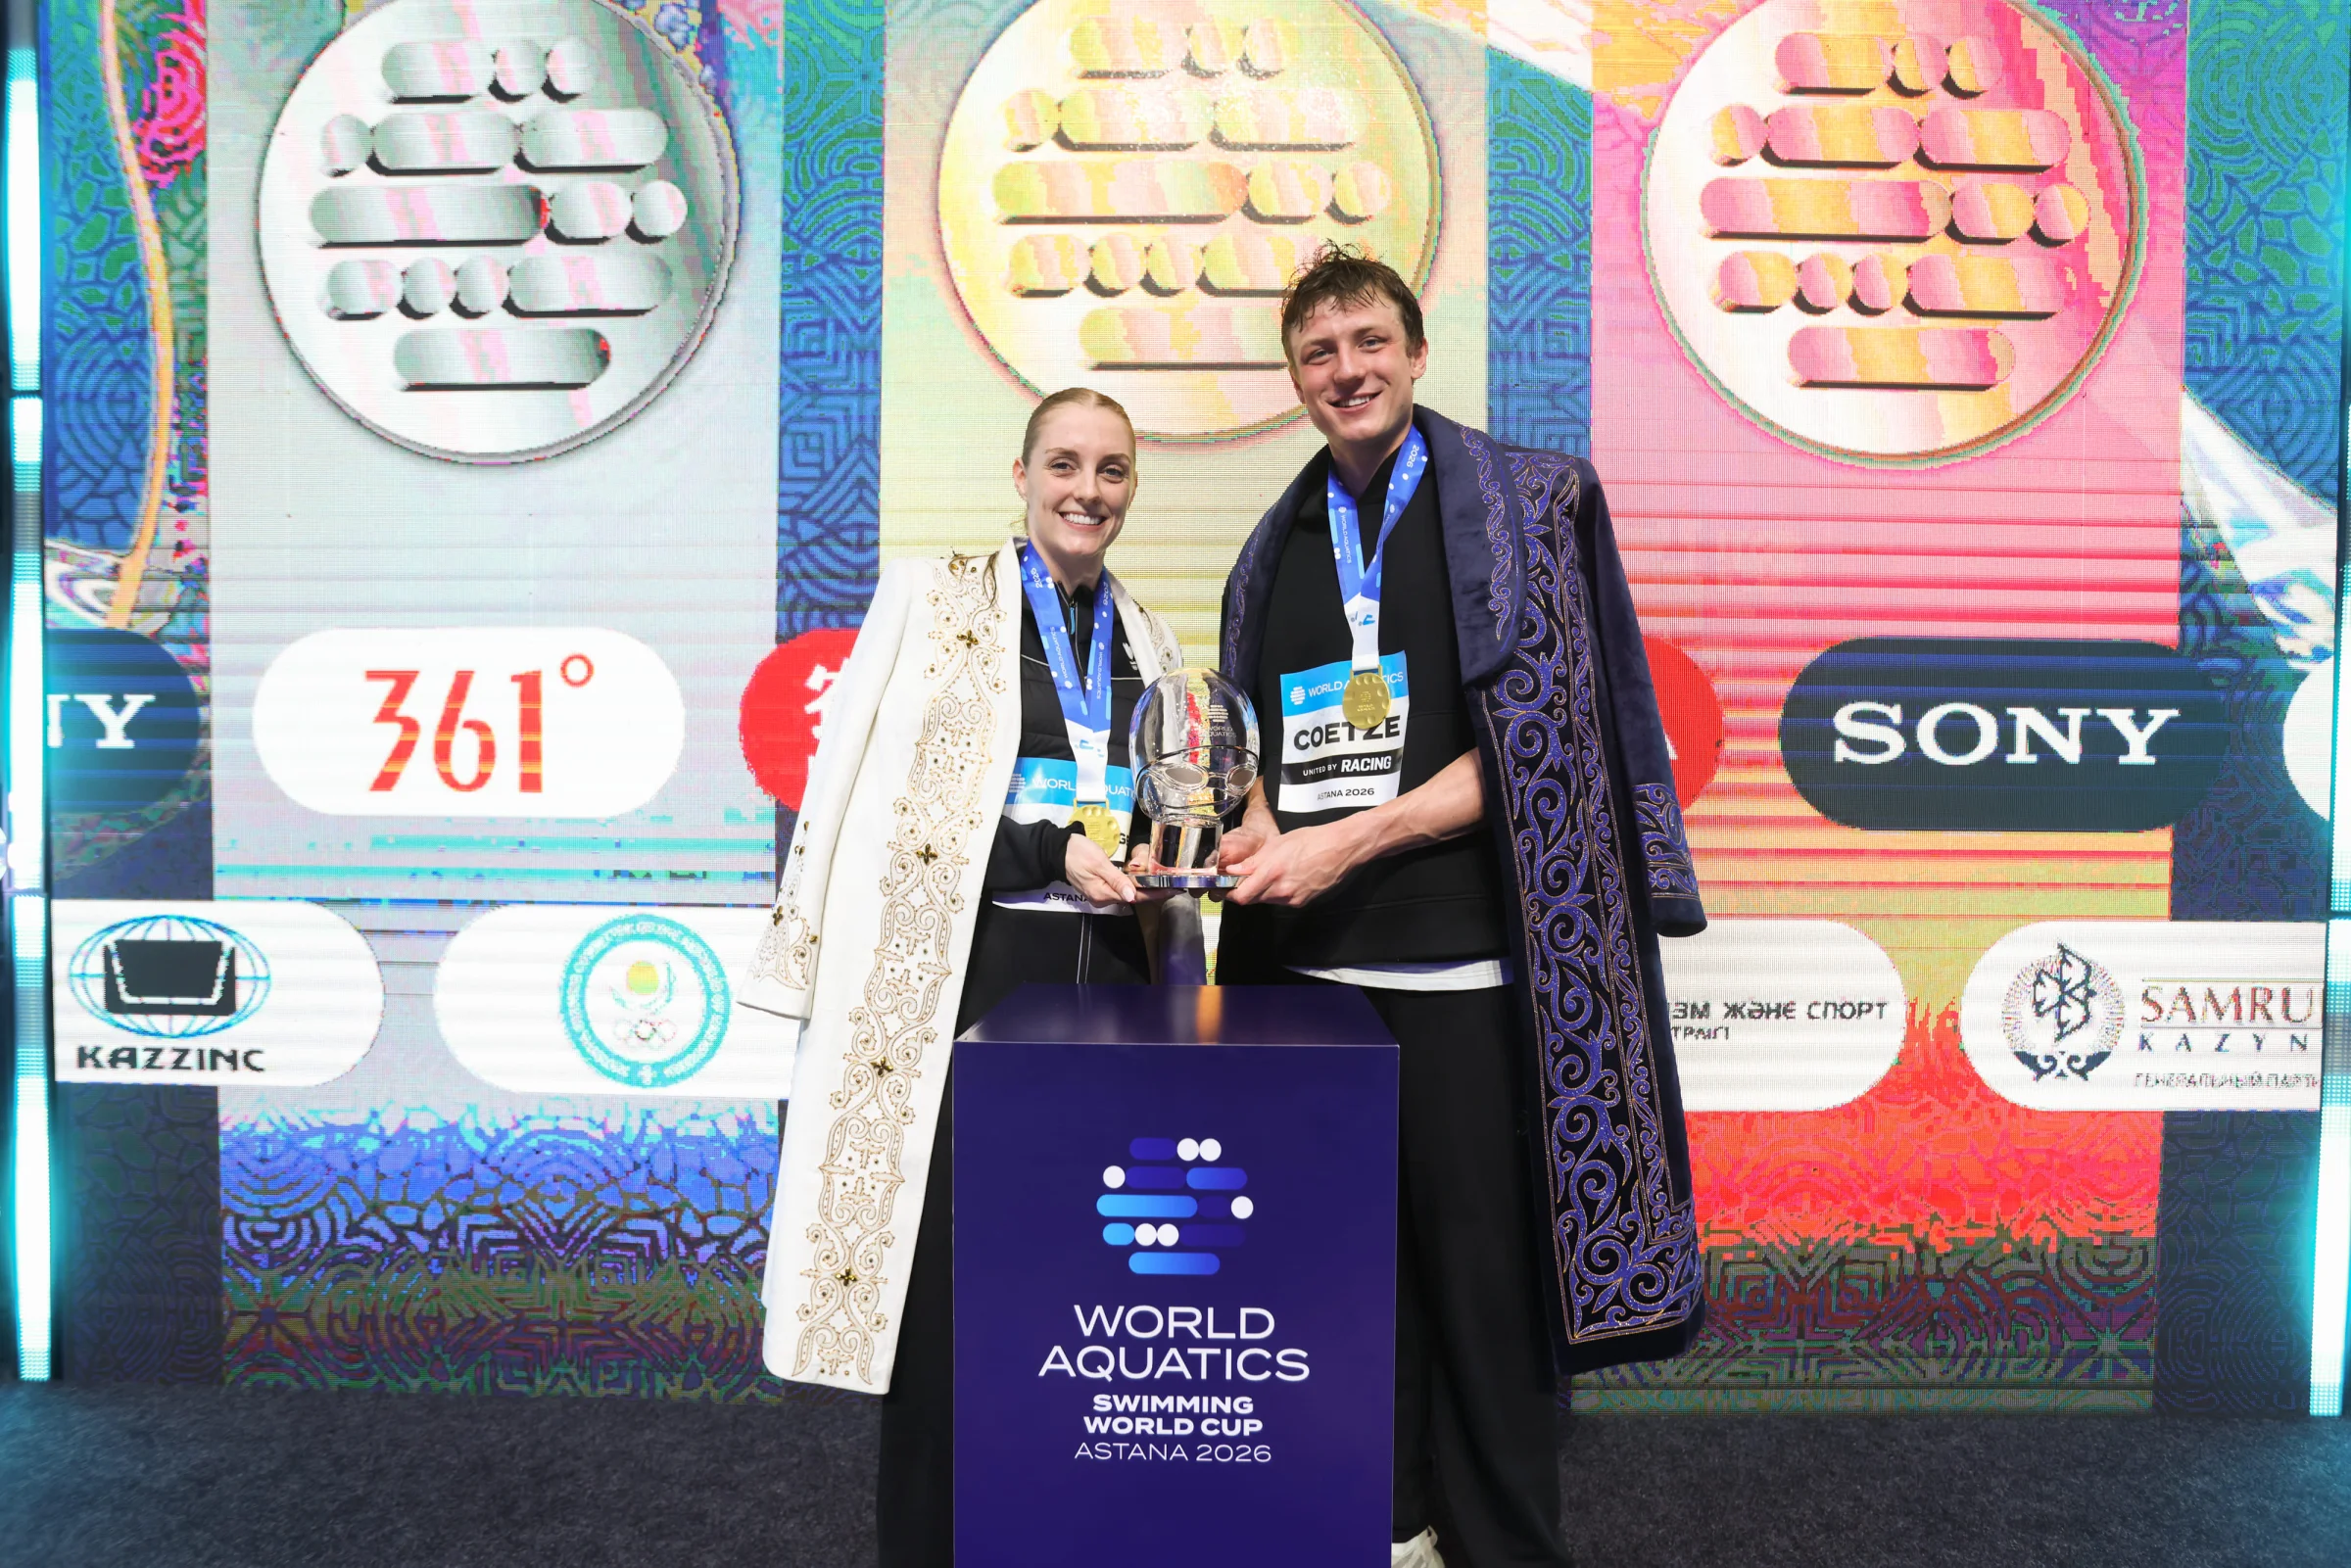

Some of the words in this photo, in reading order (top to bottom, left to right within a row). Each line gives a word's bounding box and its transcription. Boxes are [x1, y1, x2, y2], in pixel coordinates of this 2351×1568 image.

[1405, 444, 1420, 469] 2026
[1339, 514, 1349, 536] WORLD
[1342, 536, 1353, 564] AQUATICS
[1030, 567, 1043, 589] 2026
[1049, 626, 1062, 656] AQUATICS
[1058, 656, 1068, 679] WORLD
[1308, 681, 1343, 697] WORLD
[1832, 701, 2181, 766] SONY
[1303, 766, 1326, 777] UNITED
[1327, 763, 1337, 772] BY
[1340, 755, 1392, 773] RACING
[1032, 778, 1077, 791] WORL
[1317, 788, 1343, 801] ASTANA
[1345, 787, 1375, 797] 2026
[1668, 1000, 1710, 1020] ЗМ
[1722, 1000, 1797, 1021] ЖӘНЕ
[1806, 1000, 1889, 1021] СПОРТ
[2140, 985, 2324, 1023] SAMRU
[76, 1044, 265, 1073] KAZZINC
[1074, 1304, 1275, 1340] WORLD
[1038, 1345, 1311, 1383] AQUATICS
[1092, 1394, 1254, 1414] SWIMMING
[1083, 1416, 1195, 1436] WORLD
[1200, 1417, 1264, 1437] CUP
[1074, 1442, 1189, 1461] ASTANA
[1196, 1444, 1272, 1463] 2026
